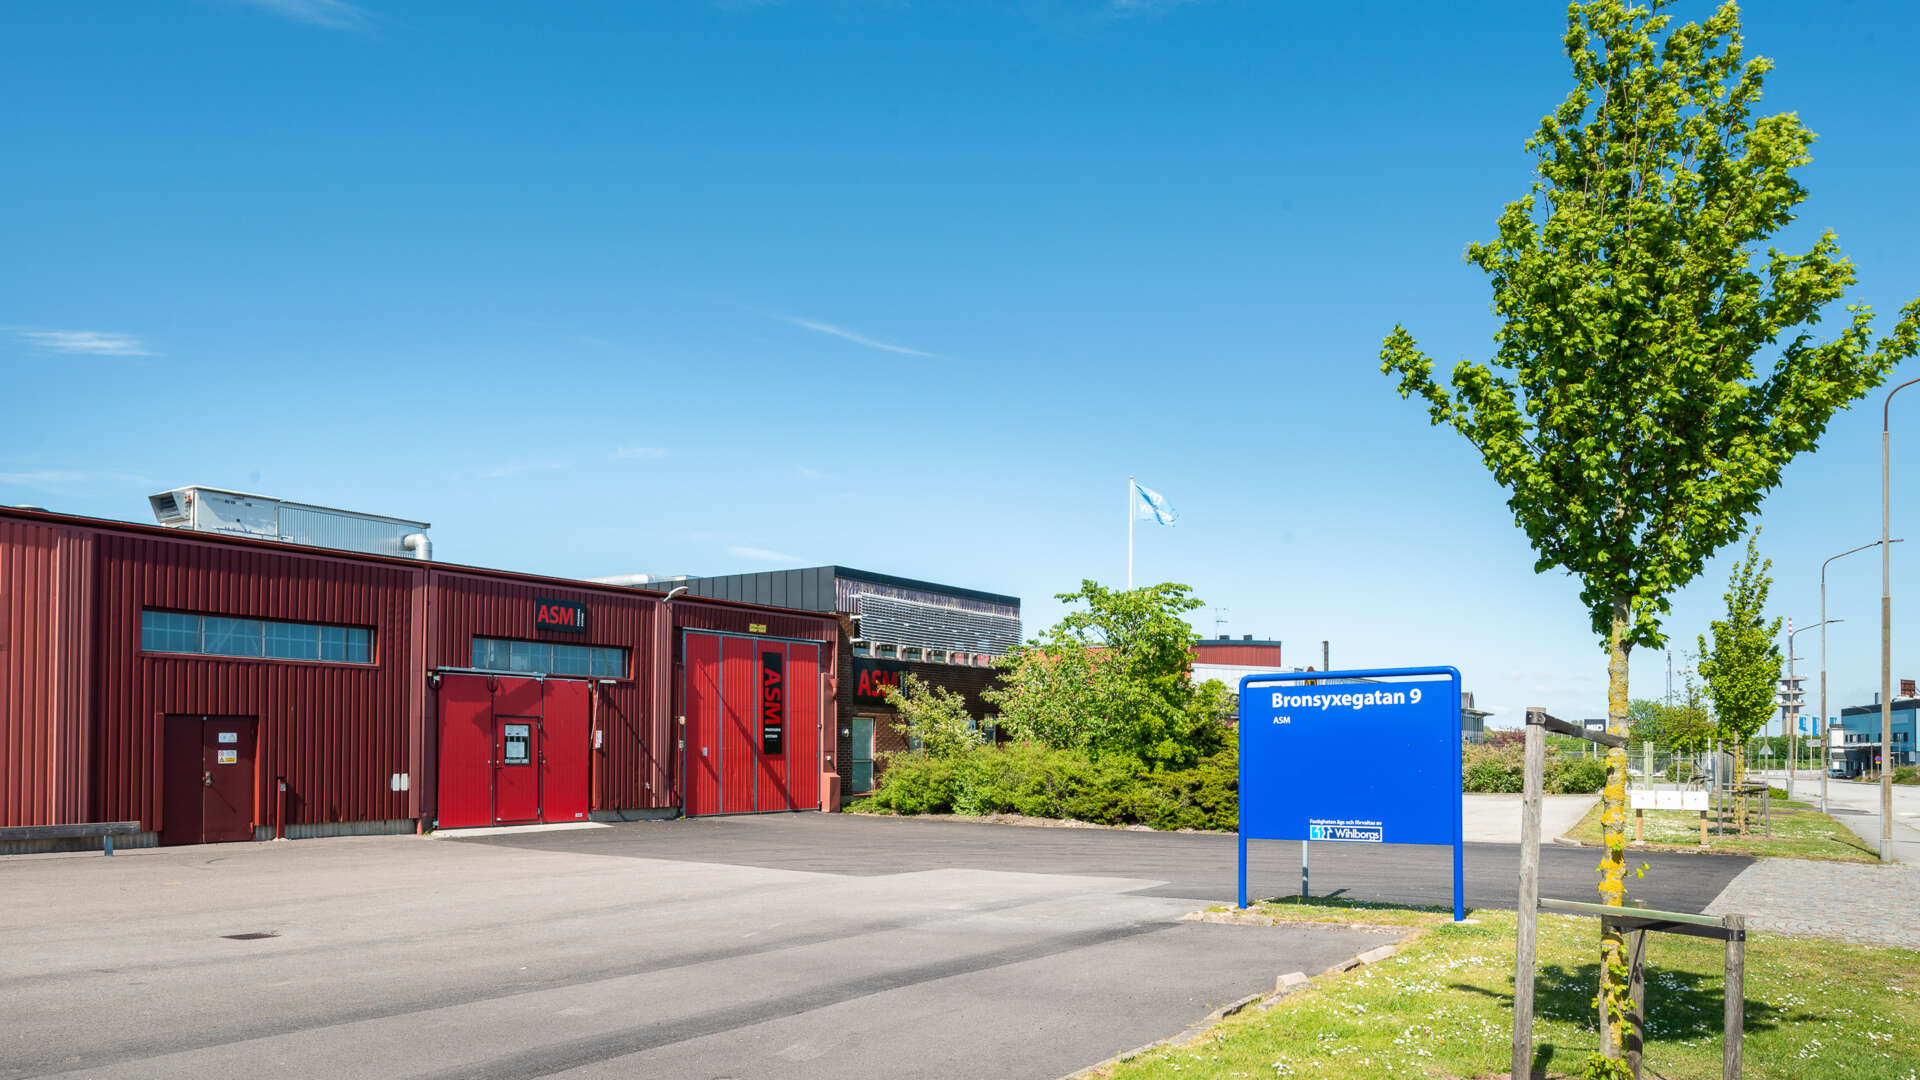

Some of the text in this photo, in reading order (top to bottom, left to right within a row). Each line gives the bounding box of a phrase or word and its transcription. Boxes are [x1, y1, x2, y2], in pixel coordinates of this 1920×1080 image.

[537, 604, 574, 627] ASM
[857, 669, 898, 697] ASM
[764, 667, 782, 725] ASM
[1272, 688, 1422, 710] Bronsyxegatan 9
[1273, 716, 1291, 724] ASM
[1334, 828, 1380, 841] Wihlborgs
